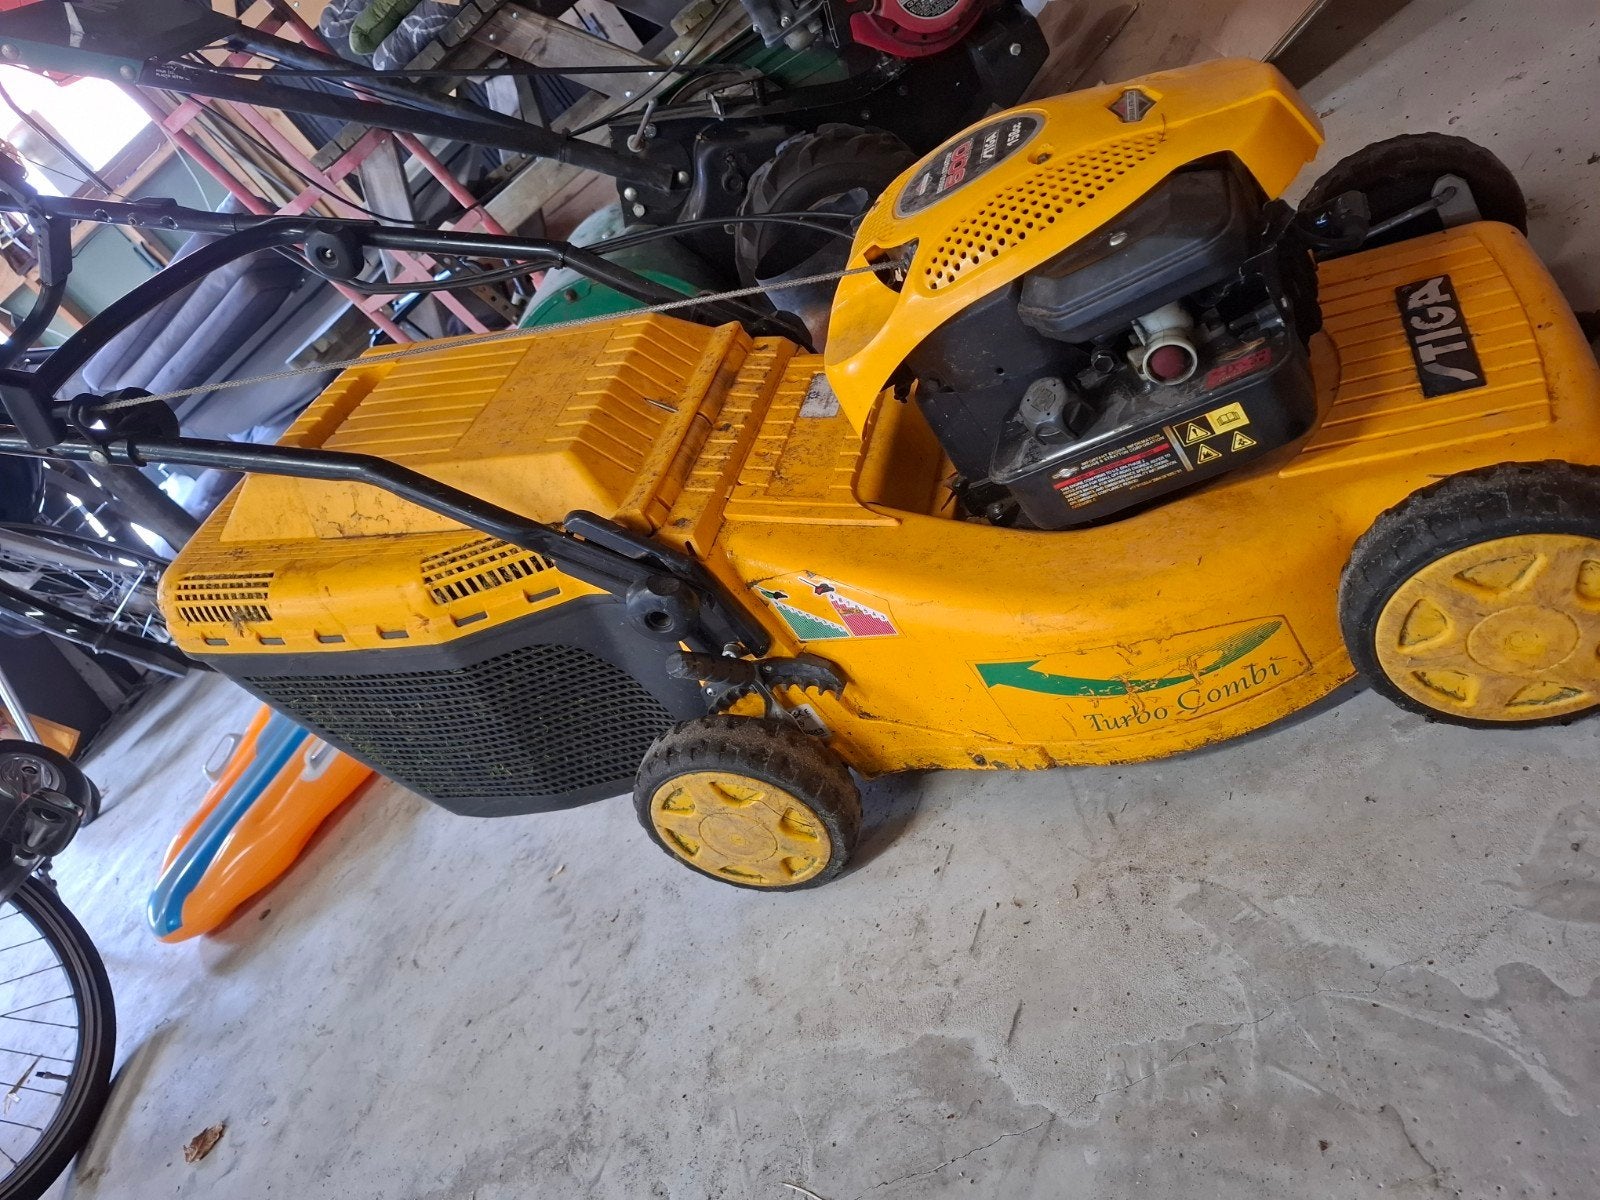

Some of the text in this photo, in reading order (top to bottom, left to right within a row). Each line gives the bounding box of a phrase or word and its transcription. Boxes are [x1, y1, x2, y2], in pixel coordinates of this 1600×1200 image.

[944, 139, 973, 190] 500
[983, 131, 999, 159] STIGA
[1406, 276, 1479, 382] STIGA
[1083, 662, 1281, 732] Turbo Combi
